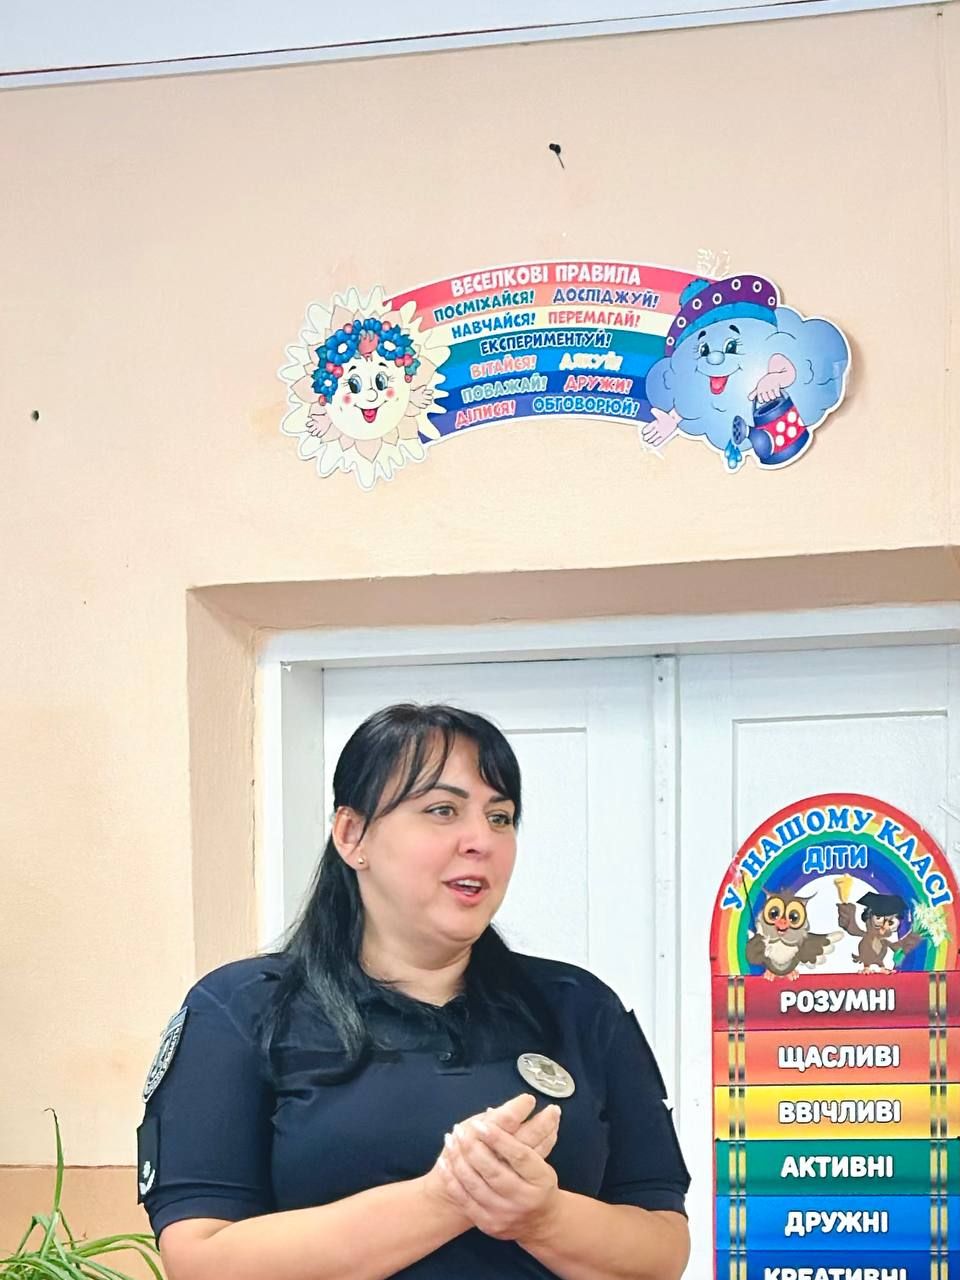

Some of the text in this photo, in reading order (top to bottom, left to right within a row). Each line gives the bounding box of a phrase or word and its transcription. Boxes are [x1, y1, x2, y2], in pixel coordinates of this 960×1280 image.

[451, 263, 641, 297] ВЕСЕЛКОВІ ПРАВИЛА
[433, 288, 659, 322] ПОСМІХАЙСЯ! ДОСЛІДЖУЙ!
[451, 310, 641, 340] НАВЧАЙСЯ! ПЕРЕМАГАЙ!
[480, 330, 613, 356] ЕКСПЕРИМЕНТУЙ!
[469, 354, 538, 380] ВІТАЙСЯ!
[461, 375, 633, 404] ПОВАЖАЙ! ДРУЖИ!
[455, 396, 639, 429] ДІЛИСЯ! ОБГОВОРЮЙ!
[721, 805, 954, 911] У НАШОМУ КЛАСІ
[803, 844, 868, 873] ДІТИ
[780, 988, 896, 1013] РОЗУМНІ
[778, 1045, 900, 1072] ЩАСЛИВІ
[778, 1099, 901, 1124] ВВІЧЛИВІ
[780, 1155, 894, 1179] АКТИВНІ
[784, 1211, 888, 1236] ДРУЖНІ
